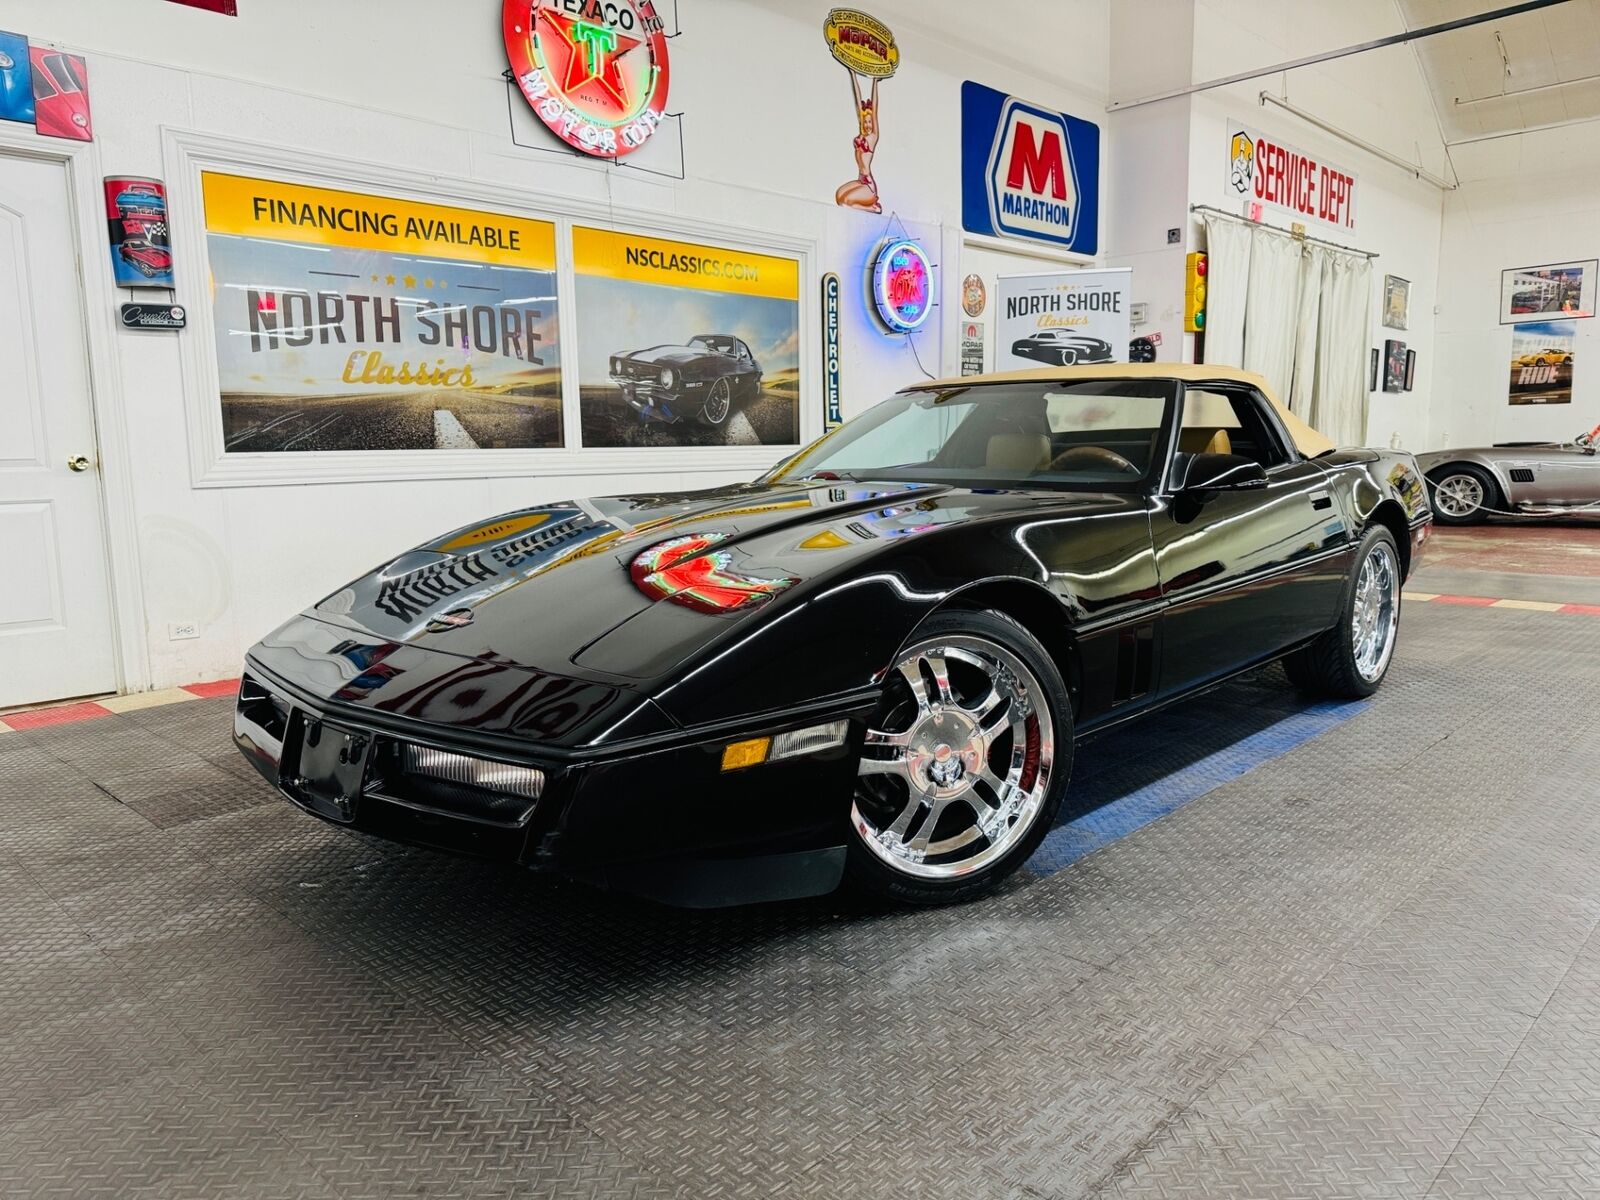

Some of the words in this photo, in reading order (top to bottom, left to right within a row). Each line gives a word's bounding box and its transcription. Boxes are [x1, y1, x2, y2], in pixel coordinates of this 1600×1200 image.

[838, 25, 888, 60] MOPAR
[520, 69, 617, 153] MOTOR
[620, 108, 664, 147] OIL
[1006, 121, 1067, 201] M
[1255, 138, 1316, 215] SERVICE
[1319, 166, 1354, 229] DEPT.
[253, 197, 398, 236] FINANCING
[404, 217, 520, 251] AVAILABLE
[1002, 192, 1070, 226] MARATHON
[626, 246, 759, 282] NSCLASSICS.COM
[123, 306, 171, 323] Corvette
[1007, 294, 1060, 319] NORTH
[1067, 291, 1121, 313] SHORE
[1036, 313, 1089, 328] Classics
[247, 288, 401, 354] NORTH
[416, 301, 544, 366] SHORE
[828, 281, 838, 419] CHEVROLET
[342, 350, 478, 388] Classics
[1518, 366, 1560, 384] RIDE
